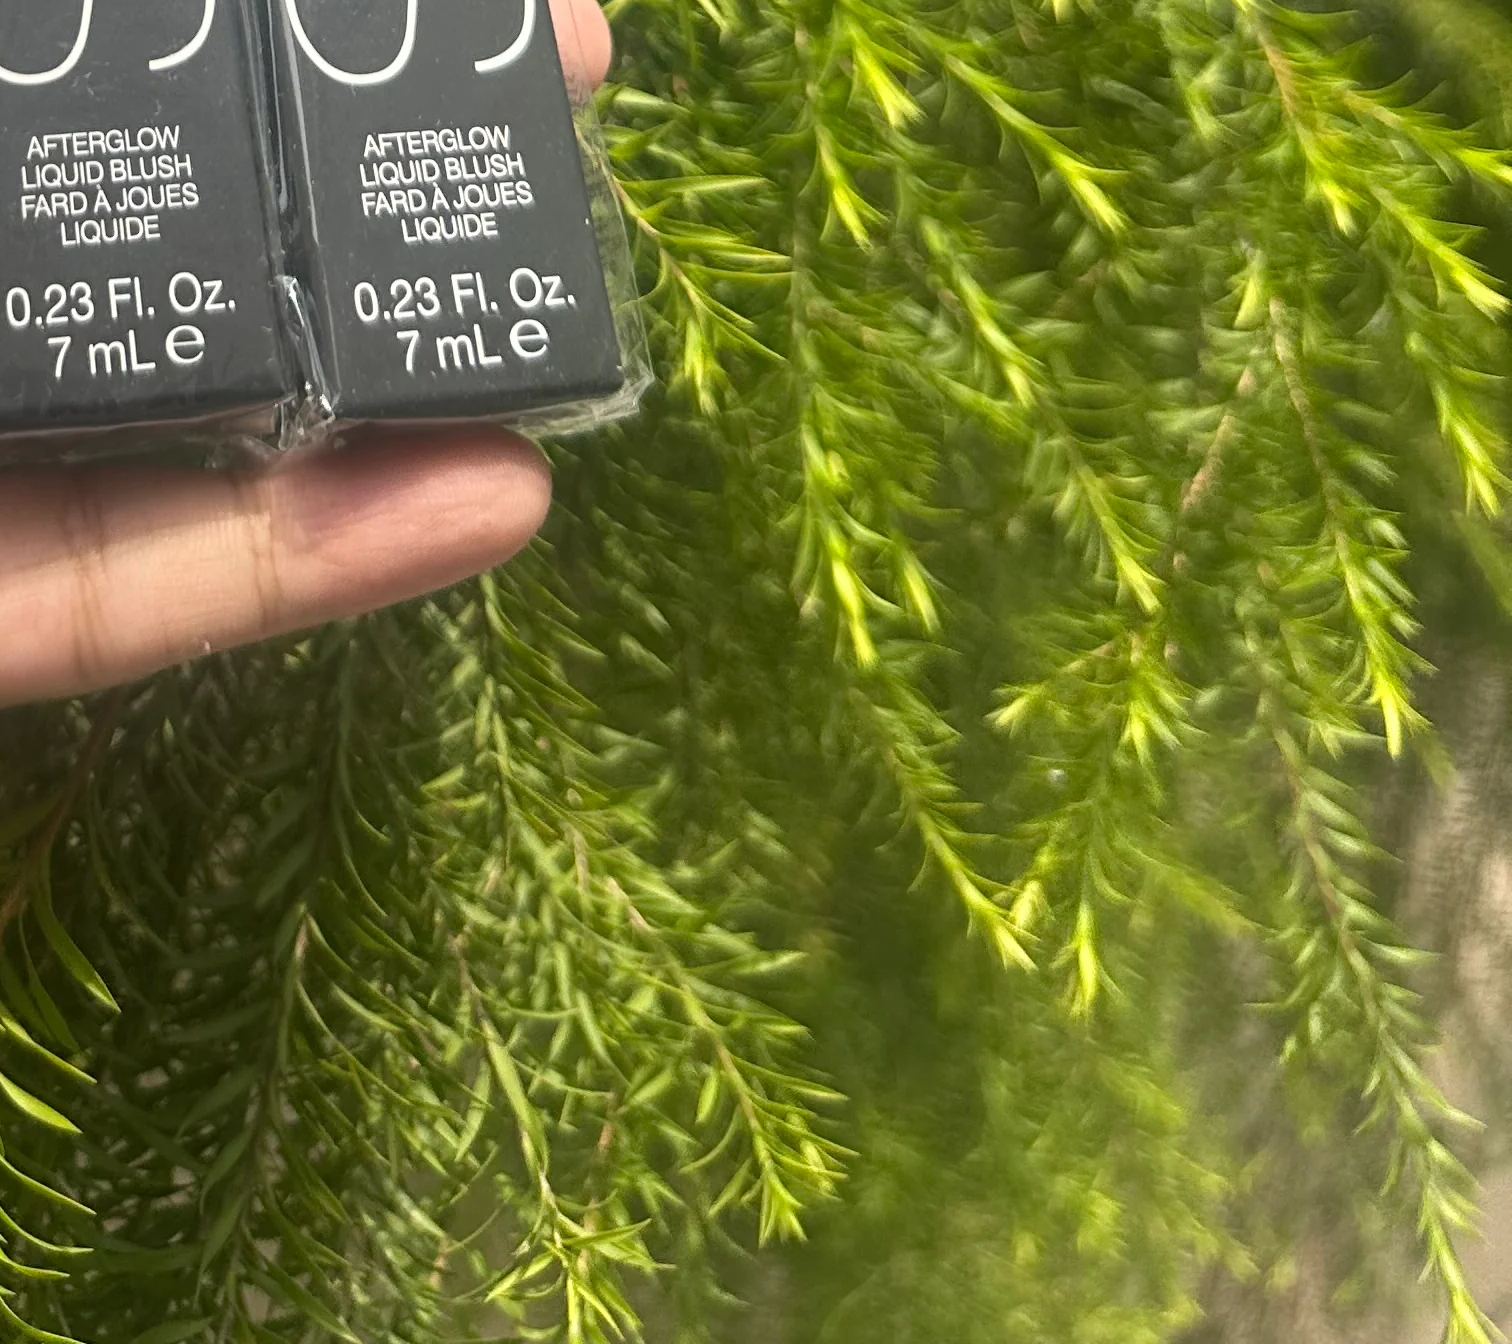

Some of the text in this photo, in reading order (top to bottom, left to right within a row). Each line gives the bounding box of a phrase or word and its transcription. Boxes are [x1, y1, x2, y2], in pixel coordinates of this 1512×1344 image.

[27, 125, 181, 159] AFTERGLOW
[363, 125, 510, 159] AFTERGLOW
[21, 154, 192, 191] LIQUID BLUSH
[359, 154, 526, 188] LIQUID BLUSH
[20, 182, 199, 220] FARD À JOUES
[361, 181, 533, 218] FARD À JOUES
[60, 214, 161, 246] LIQUIDE
[401, 213, 499, 243] LIQUIDE
[6, 271, 237, 328] 0.23 Fl. Oz.
[353, 267, 577, 324] 0.23 Fl. Oz.
[48, 337, 72, 378] 7
[89, 331, 155, 375] mL
[397, 331, 420, 373] 7
[435, 322, 502, 368] mL
